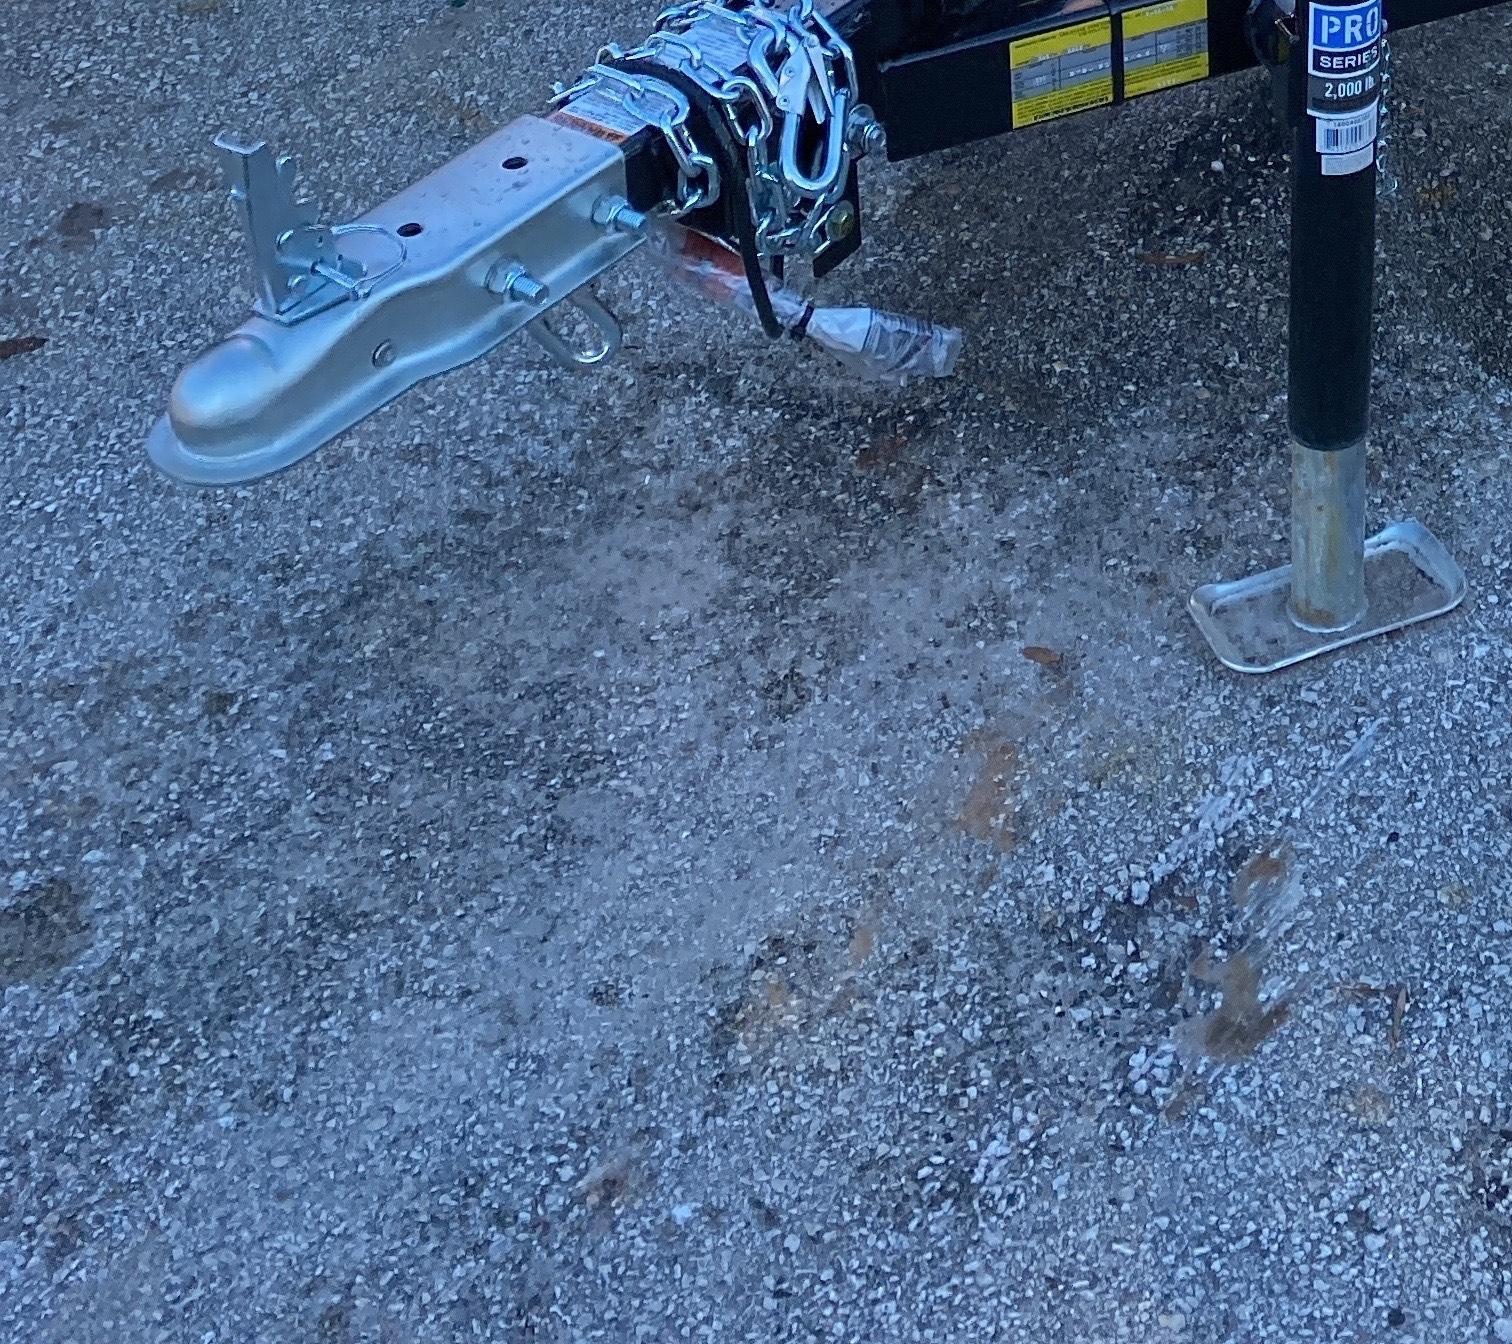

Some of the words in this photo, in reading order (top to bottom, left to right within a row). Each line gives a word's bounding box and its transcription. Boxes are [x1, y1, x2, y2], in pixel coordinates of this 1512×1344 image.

[1321, 6, 1379, 45] PRO
[1319, 46, 1378, 69] SERIES
[1324, 79, 1363, 100] 2,000
